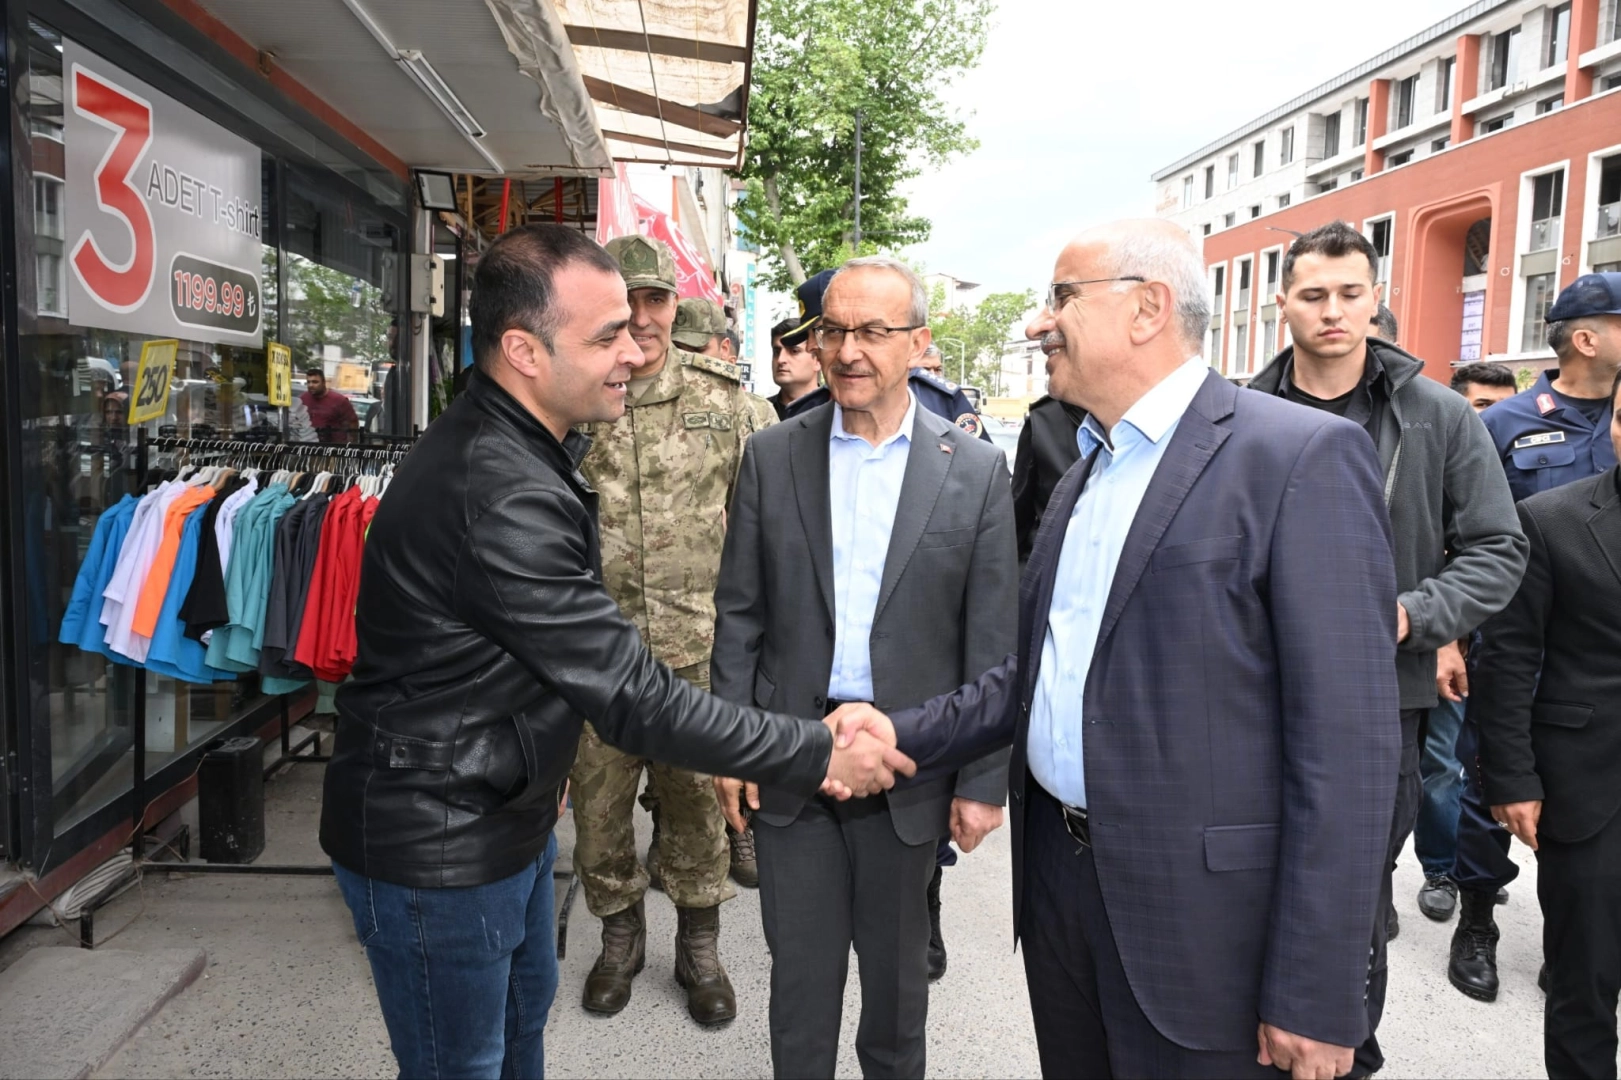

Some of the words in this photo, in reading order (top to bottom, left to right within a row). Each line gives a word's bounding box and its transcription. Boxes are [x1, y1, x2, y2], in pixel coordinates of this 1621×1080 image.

[71, 65, 156, 311] 3
[147, 161, 206, 217] ADET
[209, 187, 260, 238] T-shirt
[174, 269, 245, 318] 1199.99
[136, 365, 168, 407] 250
